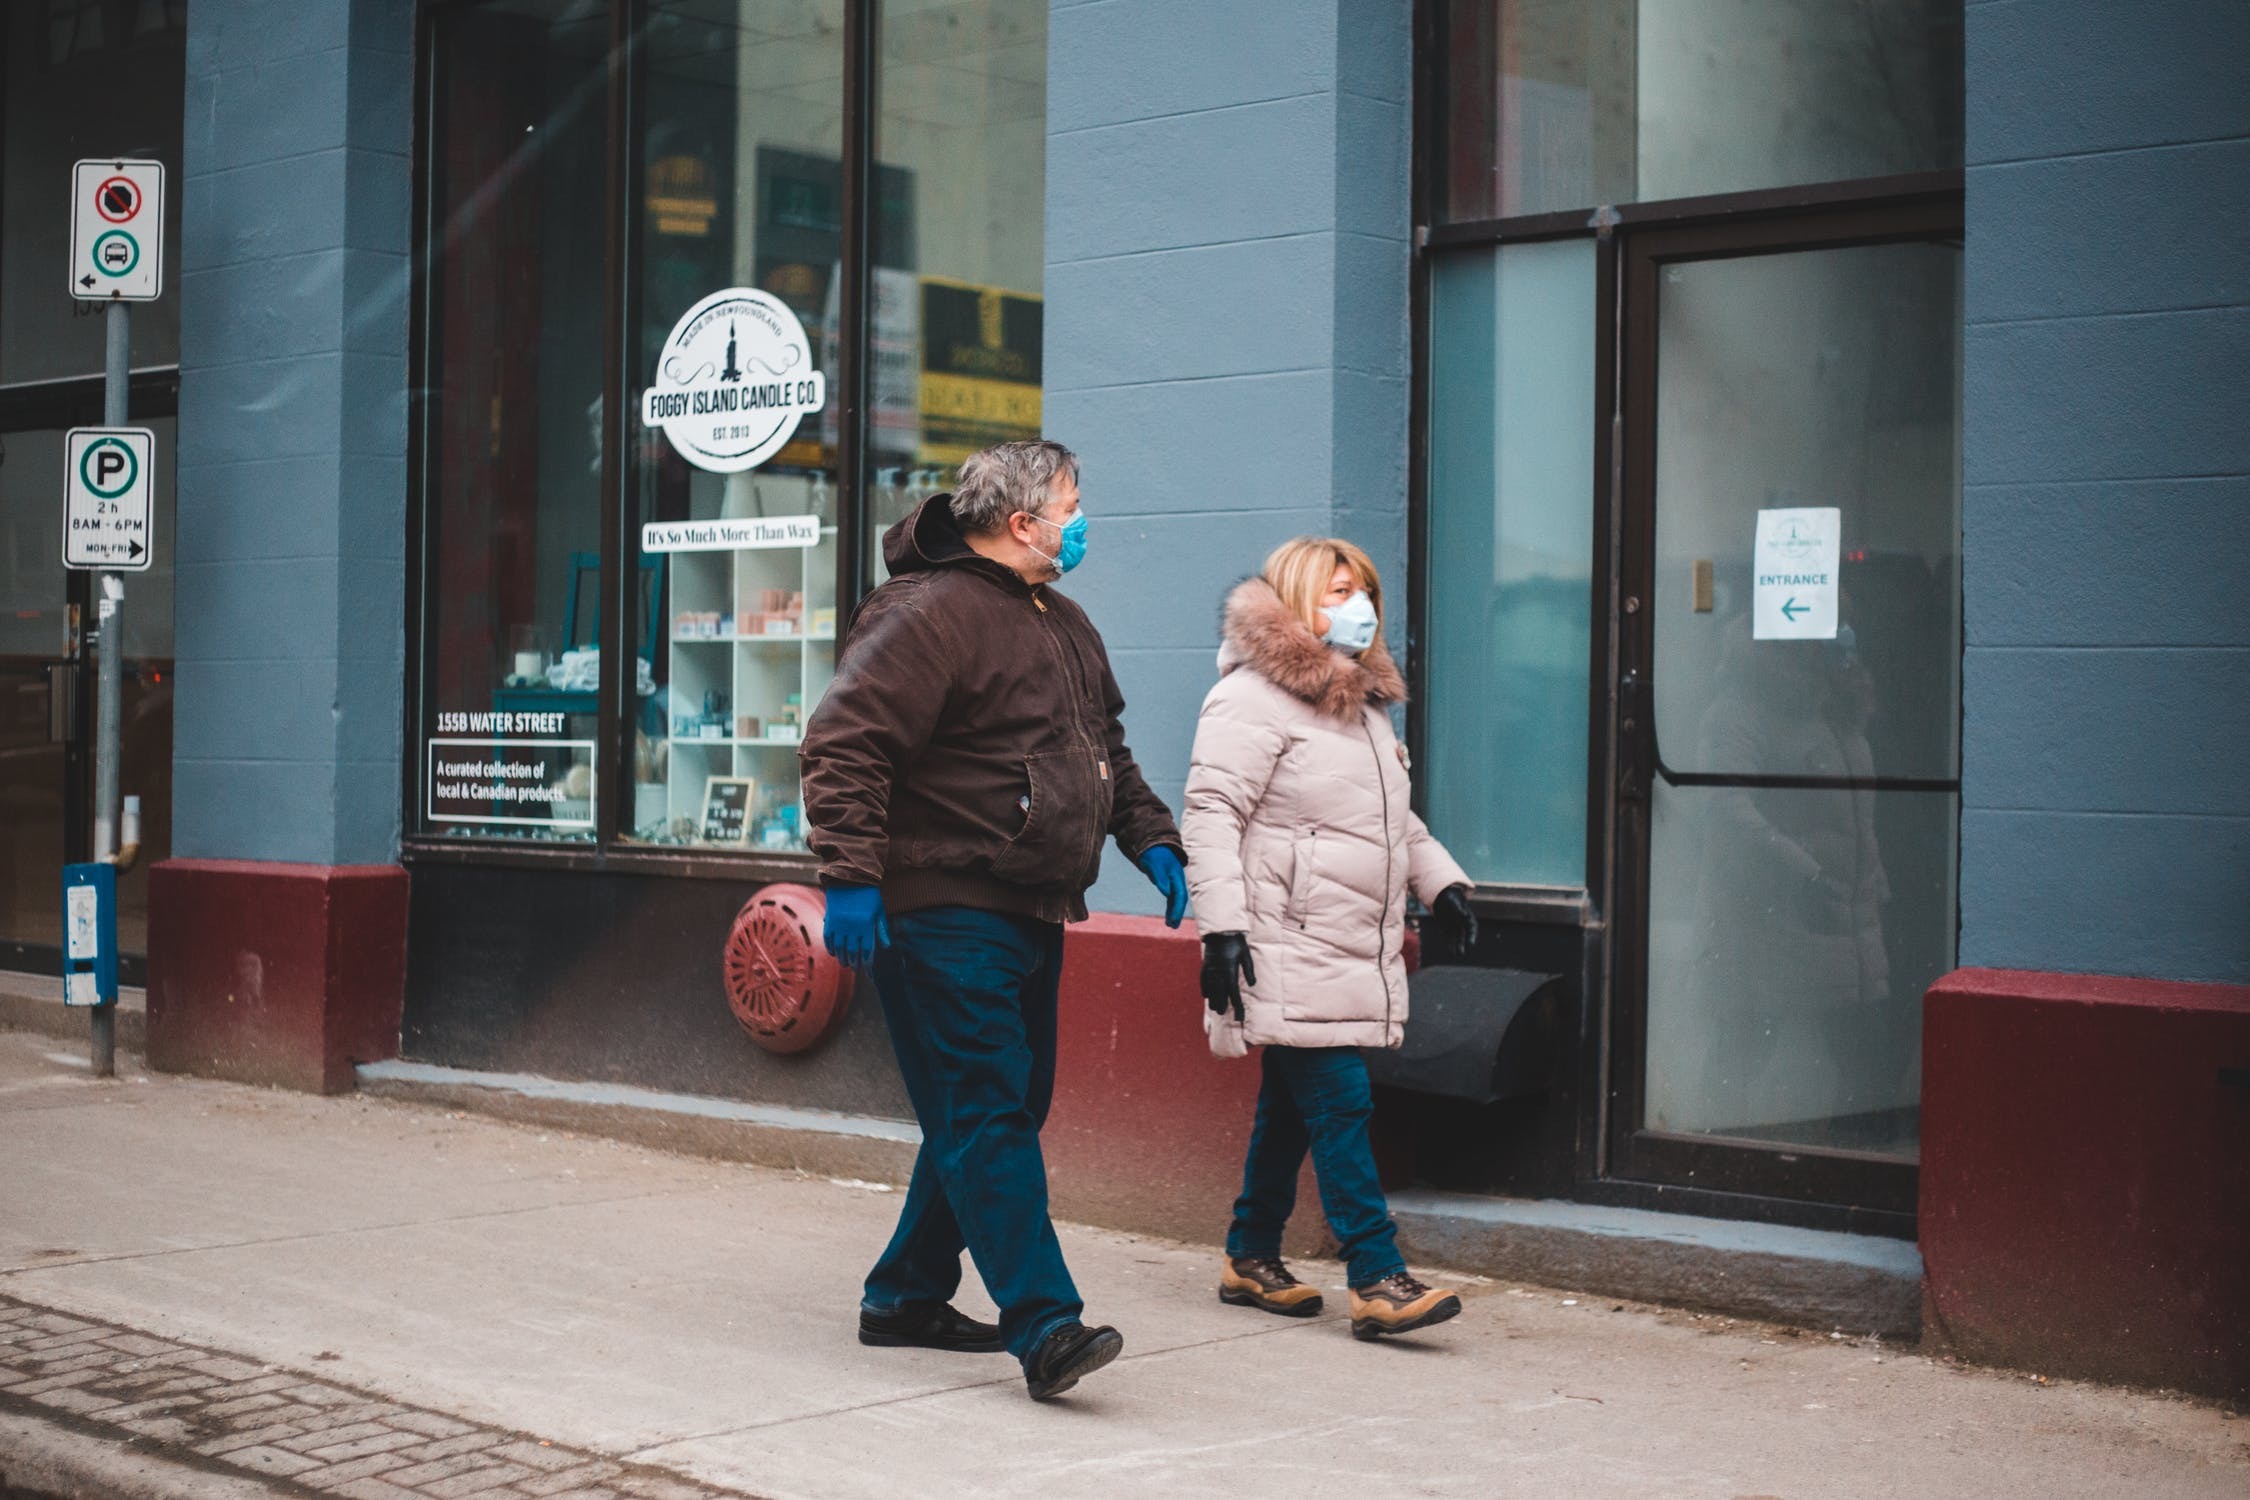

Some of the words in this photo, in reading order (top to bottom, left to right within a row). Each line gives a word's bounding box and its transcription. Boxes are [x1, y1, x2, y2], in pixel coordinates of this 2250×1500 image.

[683, 321, 703, 347] MADE
[716, 305, 782, 336] NEWFOUNDLAND
[650, 392, 690, 418] FOGGY
[693, 388, 738, 415] ISLAND
[741, 382, 792, 410] CANDLE
[797, 380, 817, 405] CO.
[713, 426, 727, 440] EST.
[730, 425, 750, 439] 2013
[97, 452, 125, 486] P
[98, 502, 106, 514] 2
[111, 502, 118, 513] h
[73, 518, 101, 531] 8AM
[115, 519, 143, 531] 6PM
[648, 530, 664, 546] It's
[667, 529, 681, 544] So
[685, 527, 717, 544] Much
[720, 526, 750, 542] More
[753, 524, 784, 540] Than
[787, 523, 813, 539] Wax
[1759, 573, 1828, 586] ENTRANCE
[437, 712, 468, 732] 155B
[469, 711, 514, 733] WATER
[515, 712, 565, 733] STREET
[437, 760, 444, 776] A
[445, 760, 482, 778] curated
[483, 760, 532, 778] collection
[533, 760, 545, 779] of
[437, 781, 460, 799] local
[461, 782, 470, 799] &
[470, 782, 517, 800] Canadian
[518, 783, 567, 804] products.
